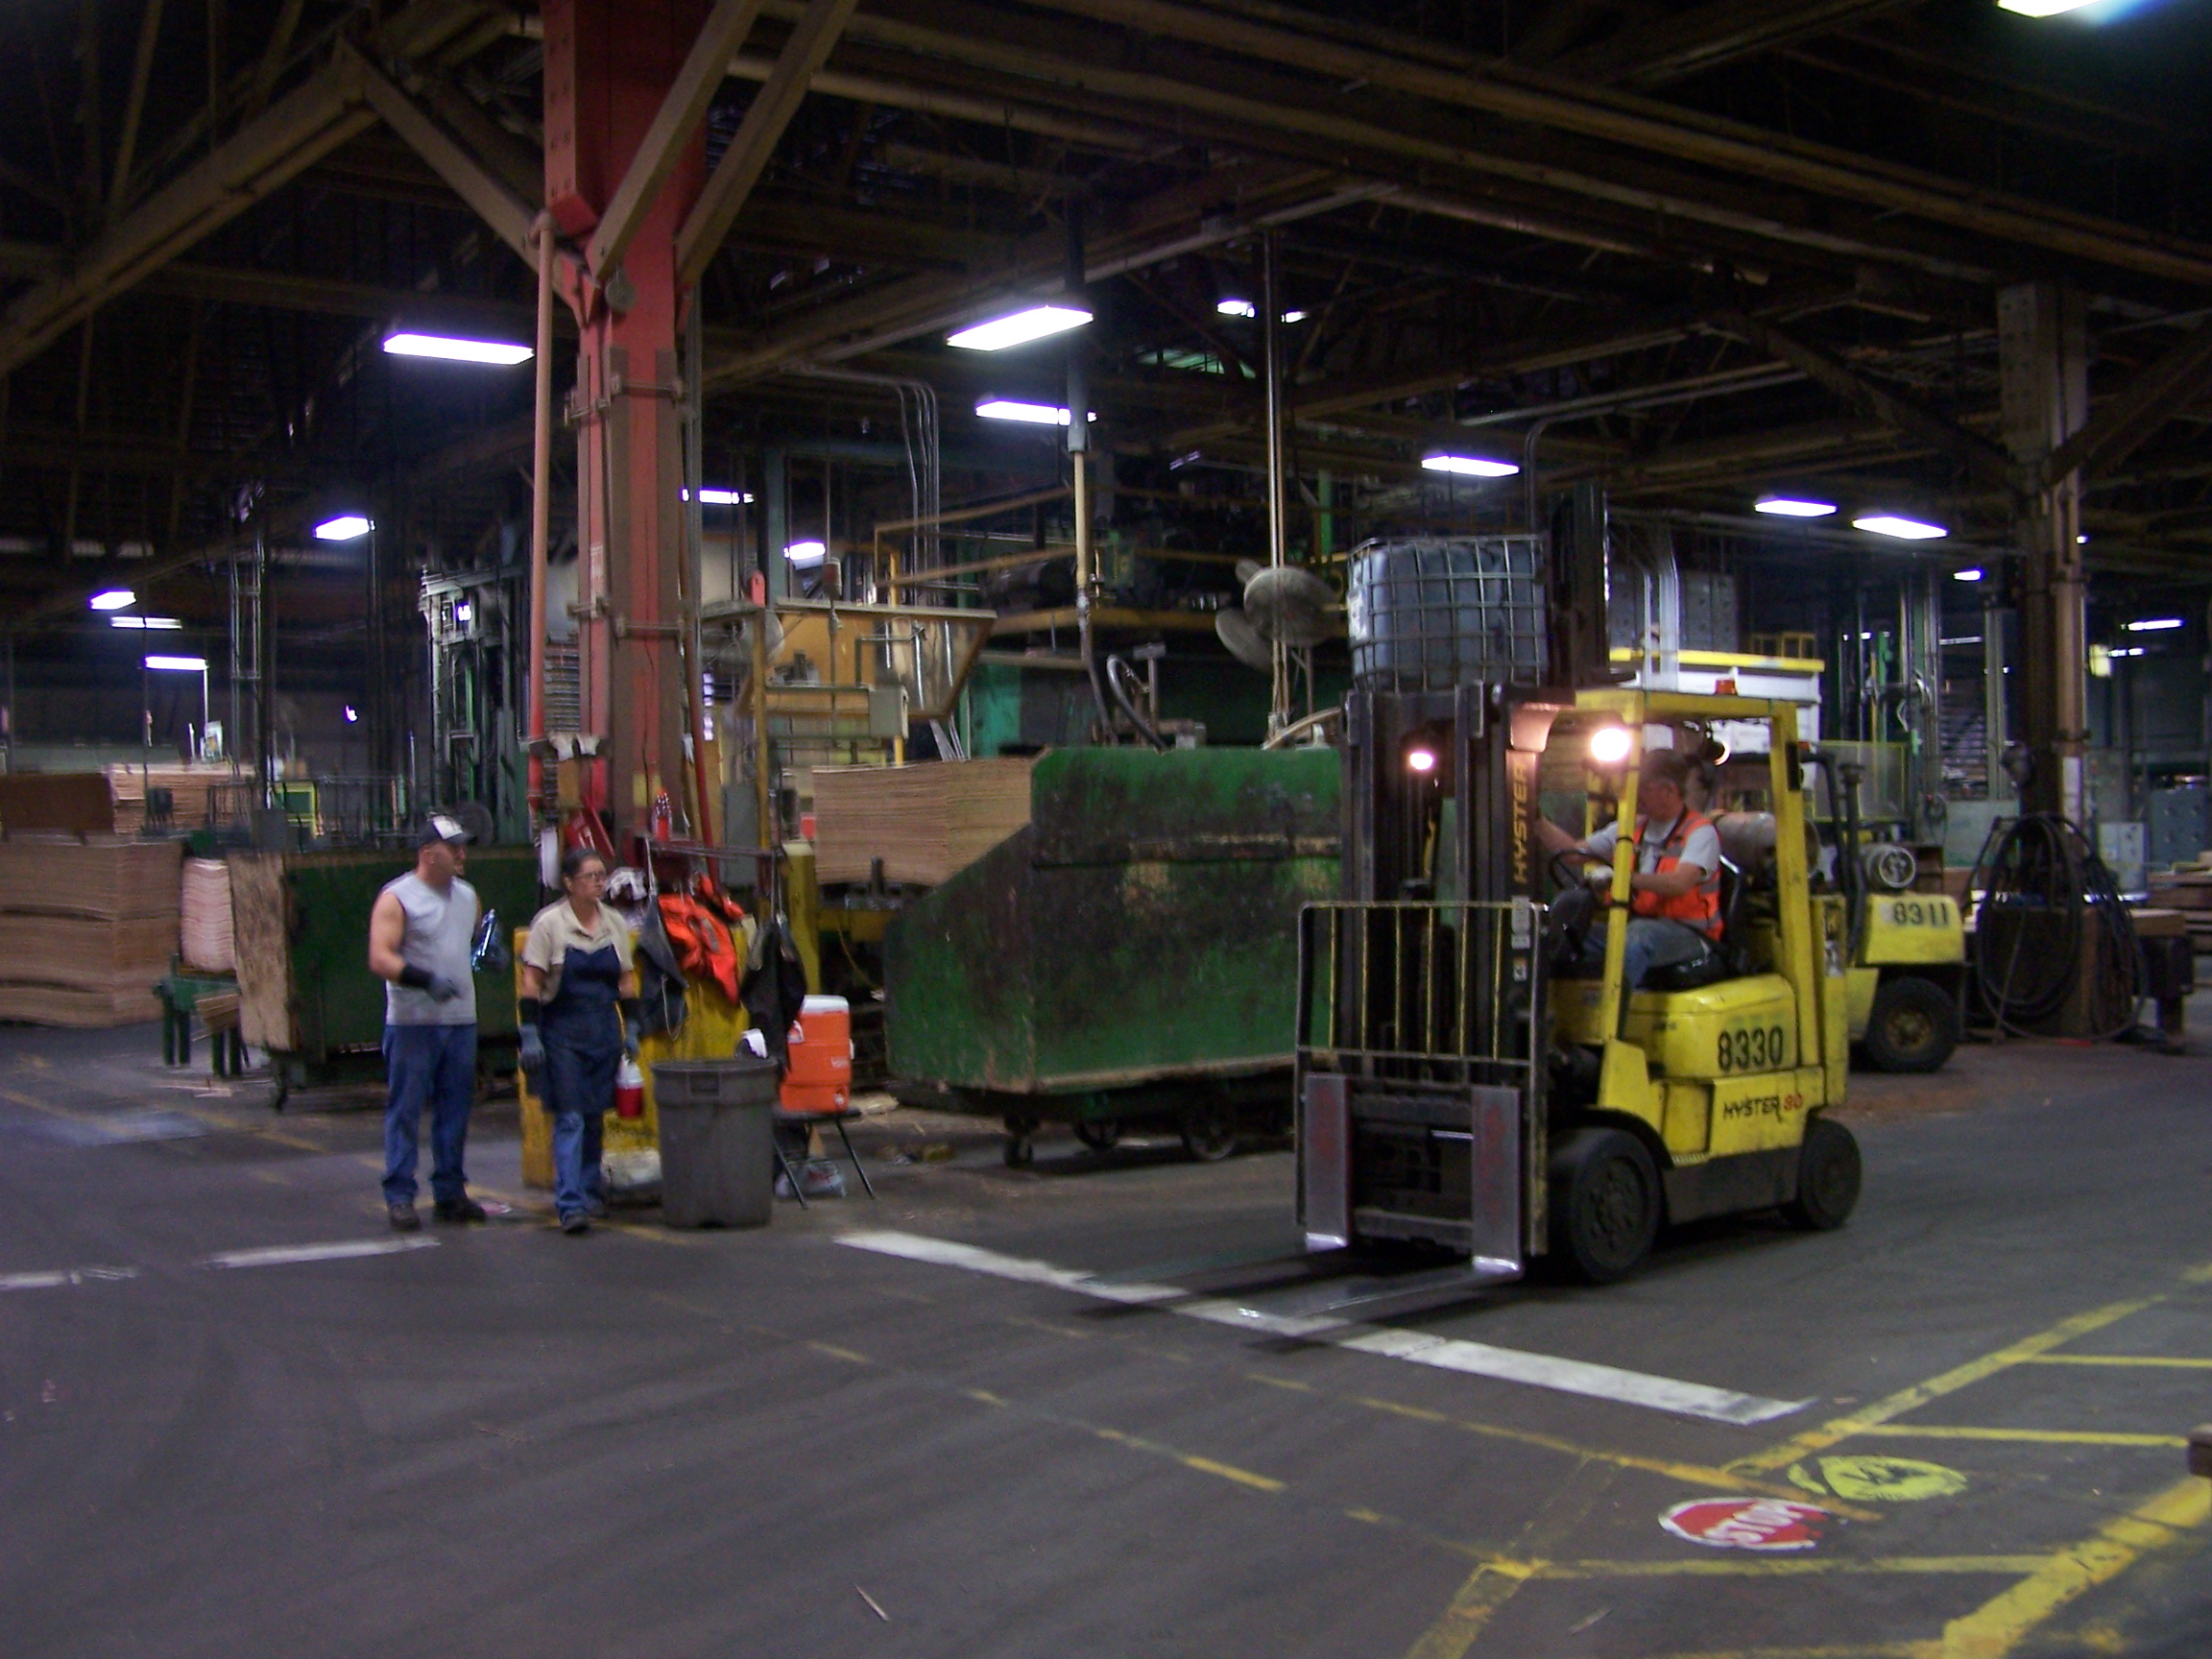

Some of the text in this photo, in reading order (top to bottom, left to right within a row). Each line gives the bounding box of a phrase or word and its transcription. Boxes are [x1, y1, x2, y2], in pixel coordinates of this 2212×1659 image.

[1512, 761, 1528, 884] HYSTER
[1894, 902, 1949, 926] 8311
[1718, 1024, 1784, 1070] 8330
[1722, 1095, 1782, 1121] HYSTER
